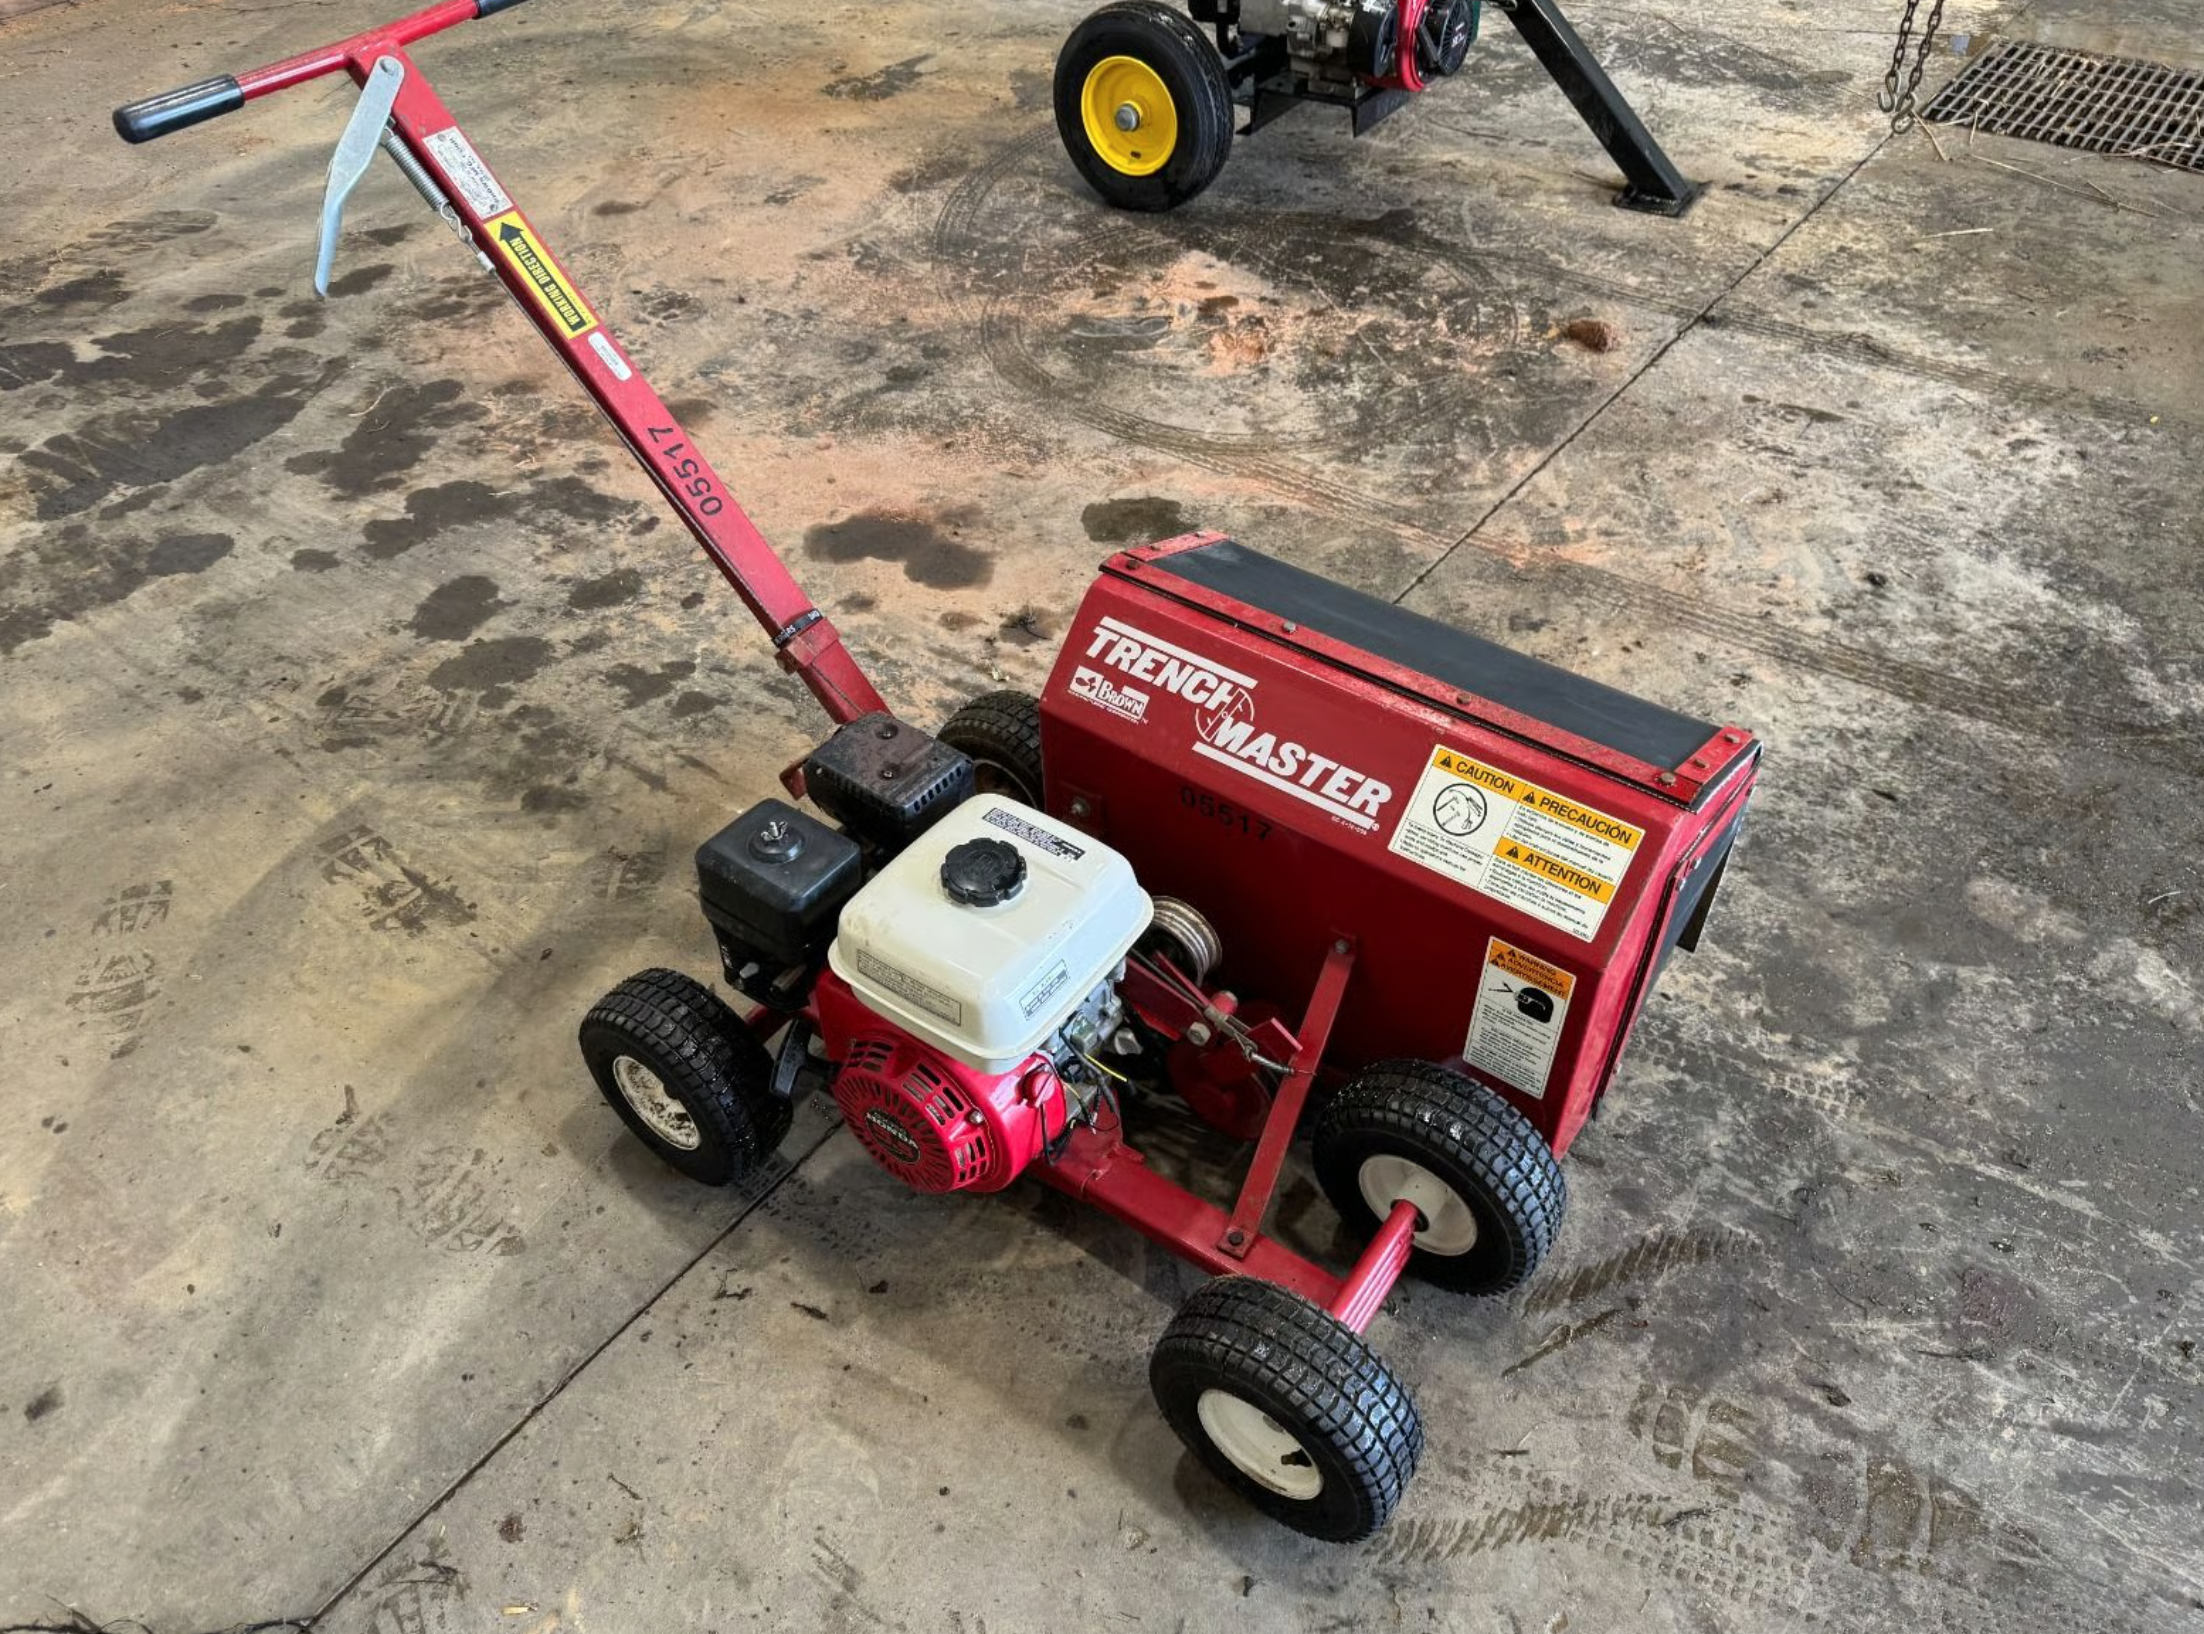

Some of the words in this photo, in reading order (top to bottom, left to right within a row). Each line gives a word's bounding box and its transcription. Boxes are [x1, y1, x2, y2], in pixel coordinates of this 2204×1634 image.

[509, 237, 551, 284] DIRECTION
[545, 283, 581, 325] WORKING
[647, 427, 723, 517] 05517
[1086, 626, 1241, 710] TRENCH
[1212, 714, 1393, 817] MASTER
[1455, 760, 1515, 794] CAUTION
[1180, 785, 1273, 841] 05517
[1538, 796, 1633, 845] PRECAUCIÓN
[1523, 852, 1602, 896] ATTENTION
